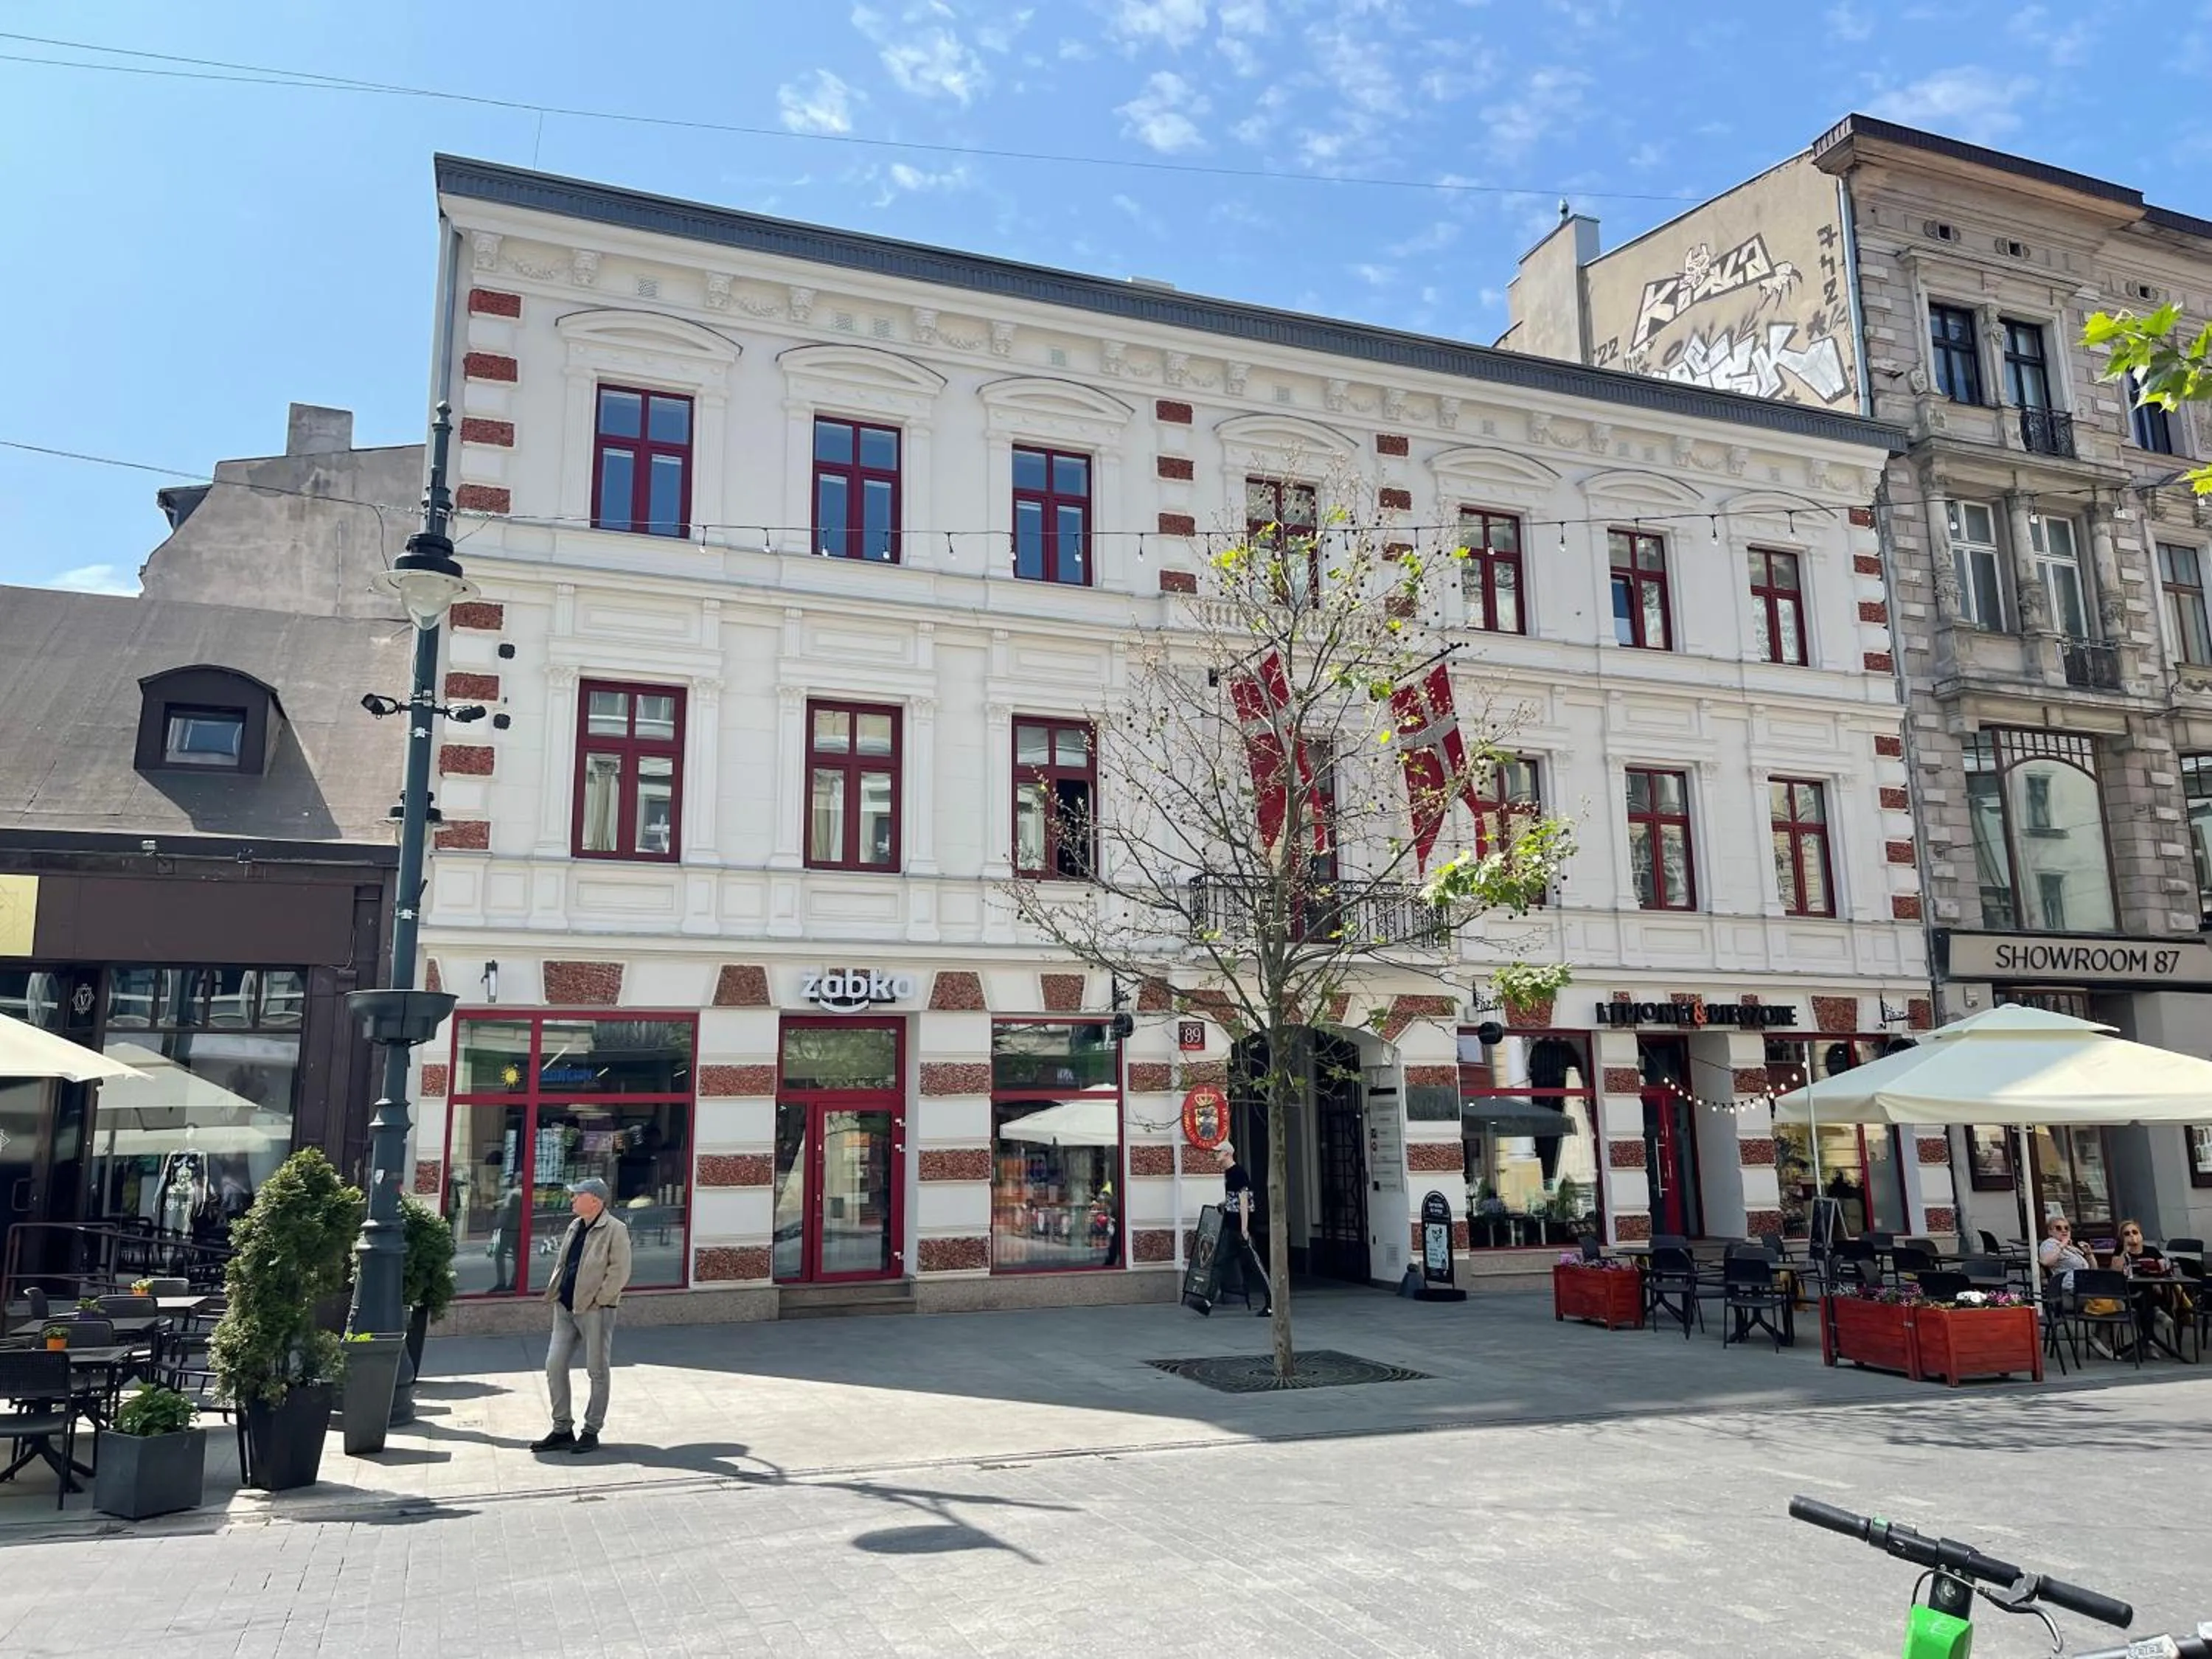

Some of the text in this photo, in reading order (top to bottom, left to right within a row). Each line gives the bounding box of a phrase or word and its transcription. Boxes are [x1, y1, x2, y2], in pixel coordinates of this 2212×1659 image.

[1994, 944, 2181, 974] SHOWROOM 87
[1185, 1027, 1202, 1043] 89
